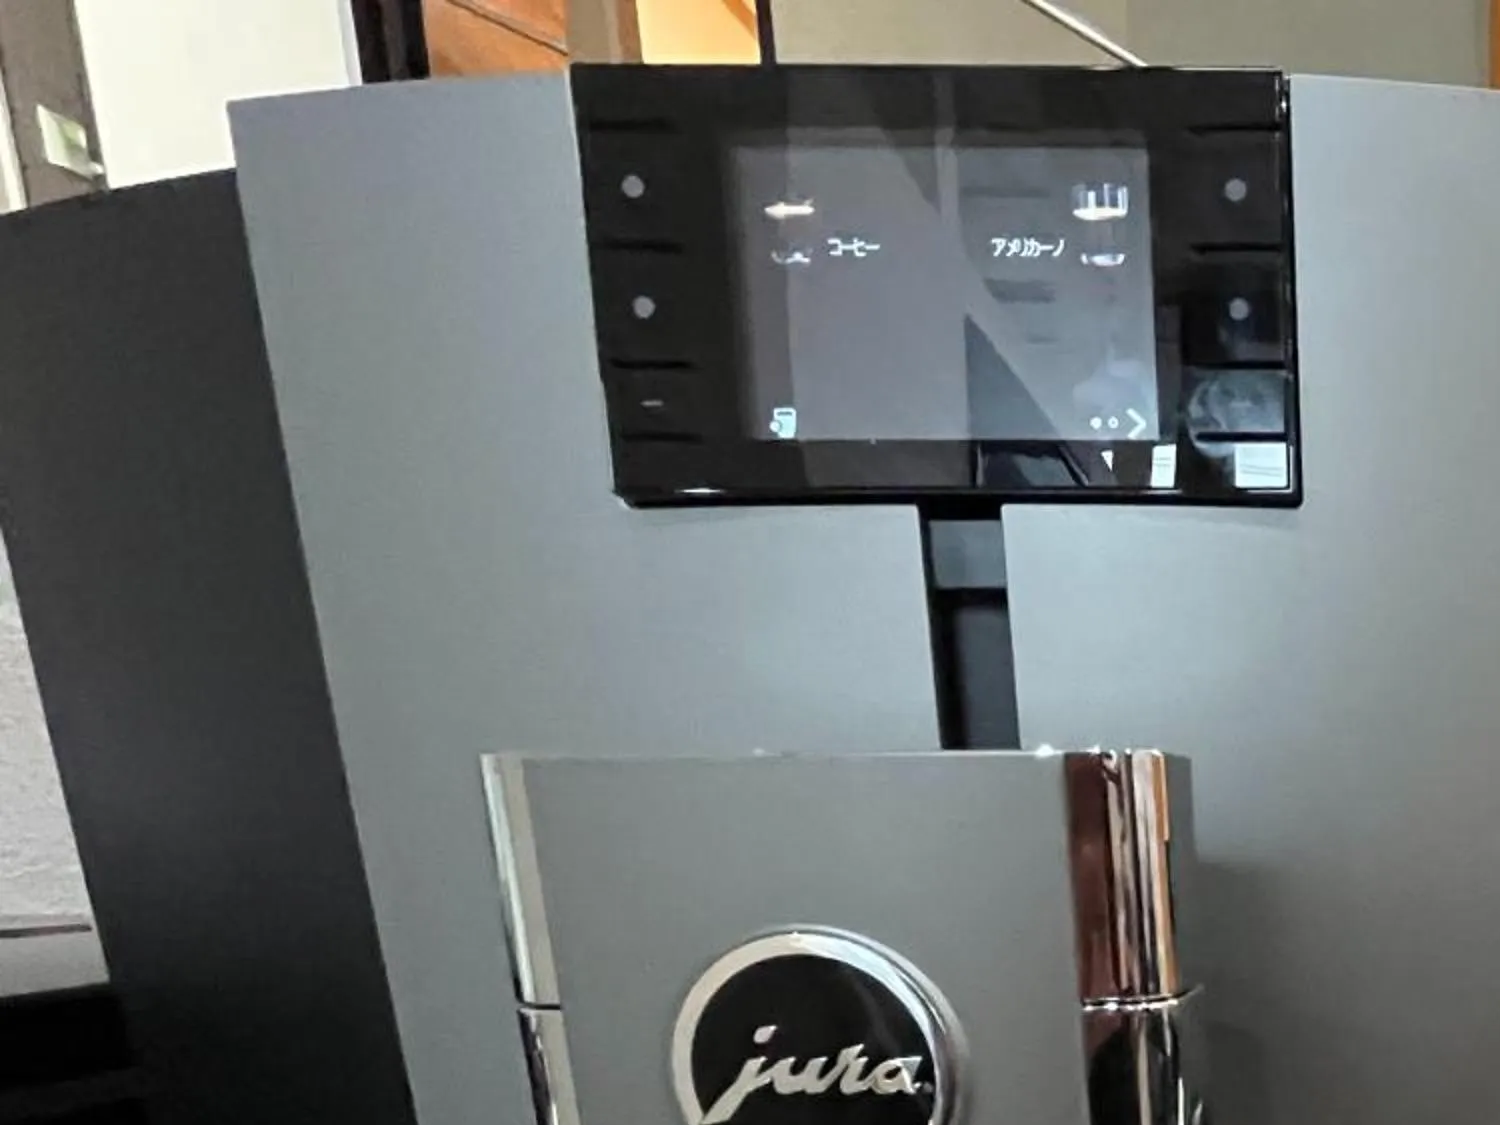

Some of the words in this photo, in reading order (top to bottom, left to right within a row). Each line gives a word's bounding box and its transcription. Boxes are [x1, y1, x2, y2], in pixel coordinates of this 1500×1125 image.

[827, 237, 881, 257] コーヒー
[991, 237, 1065, 257] アメリカーノ
